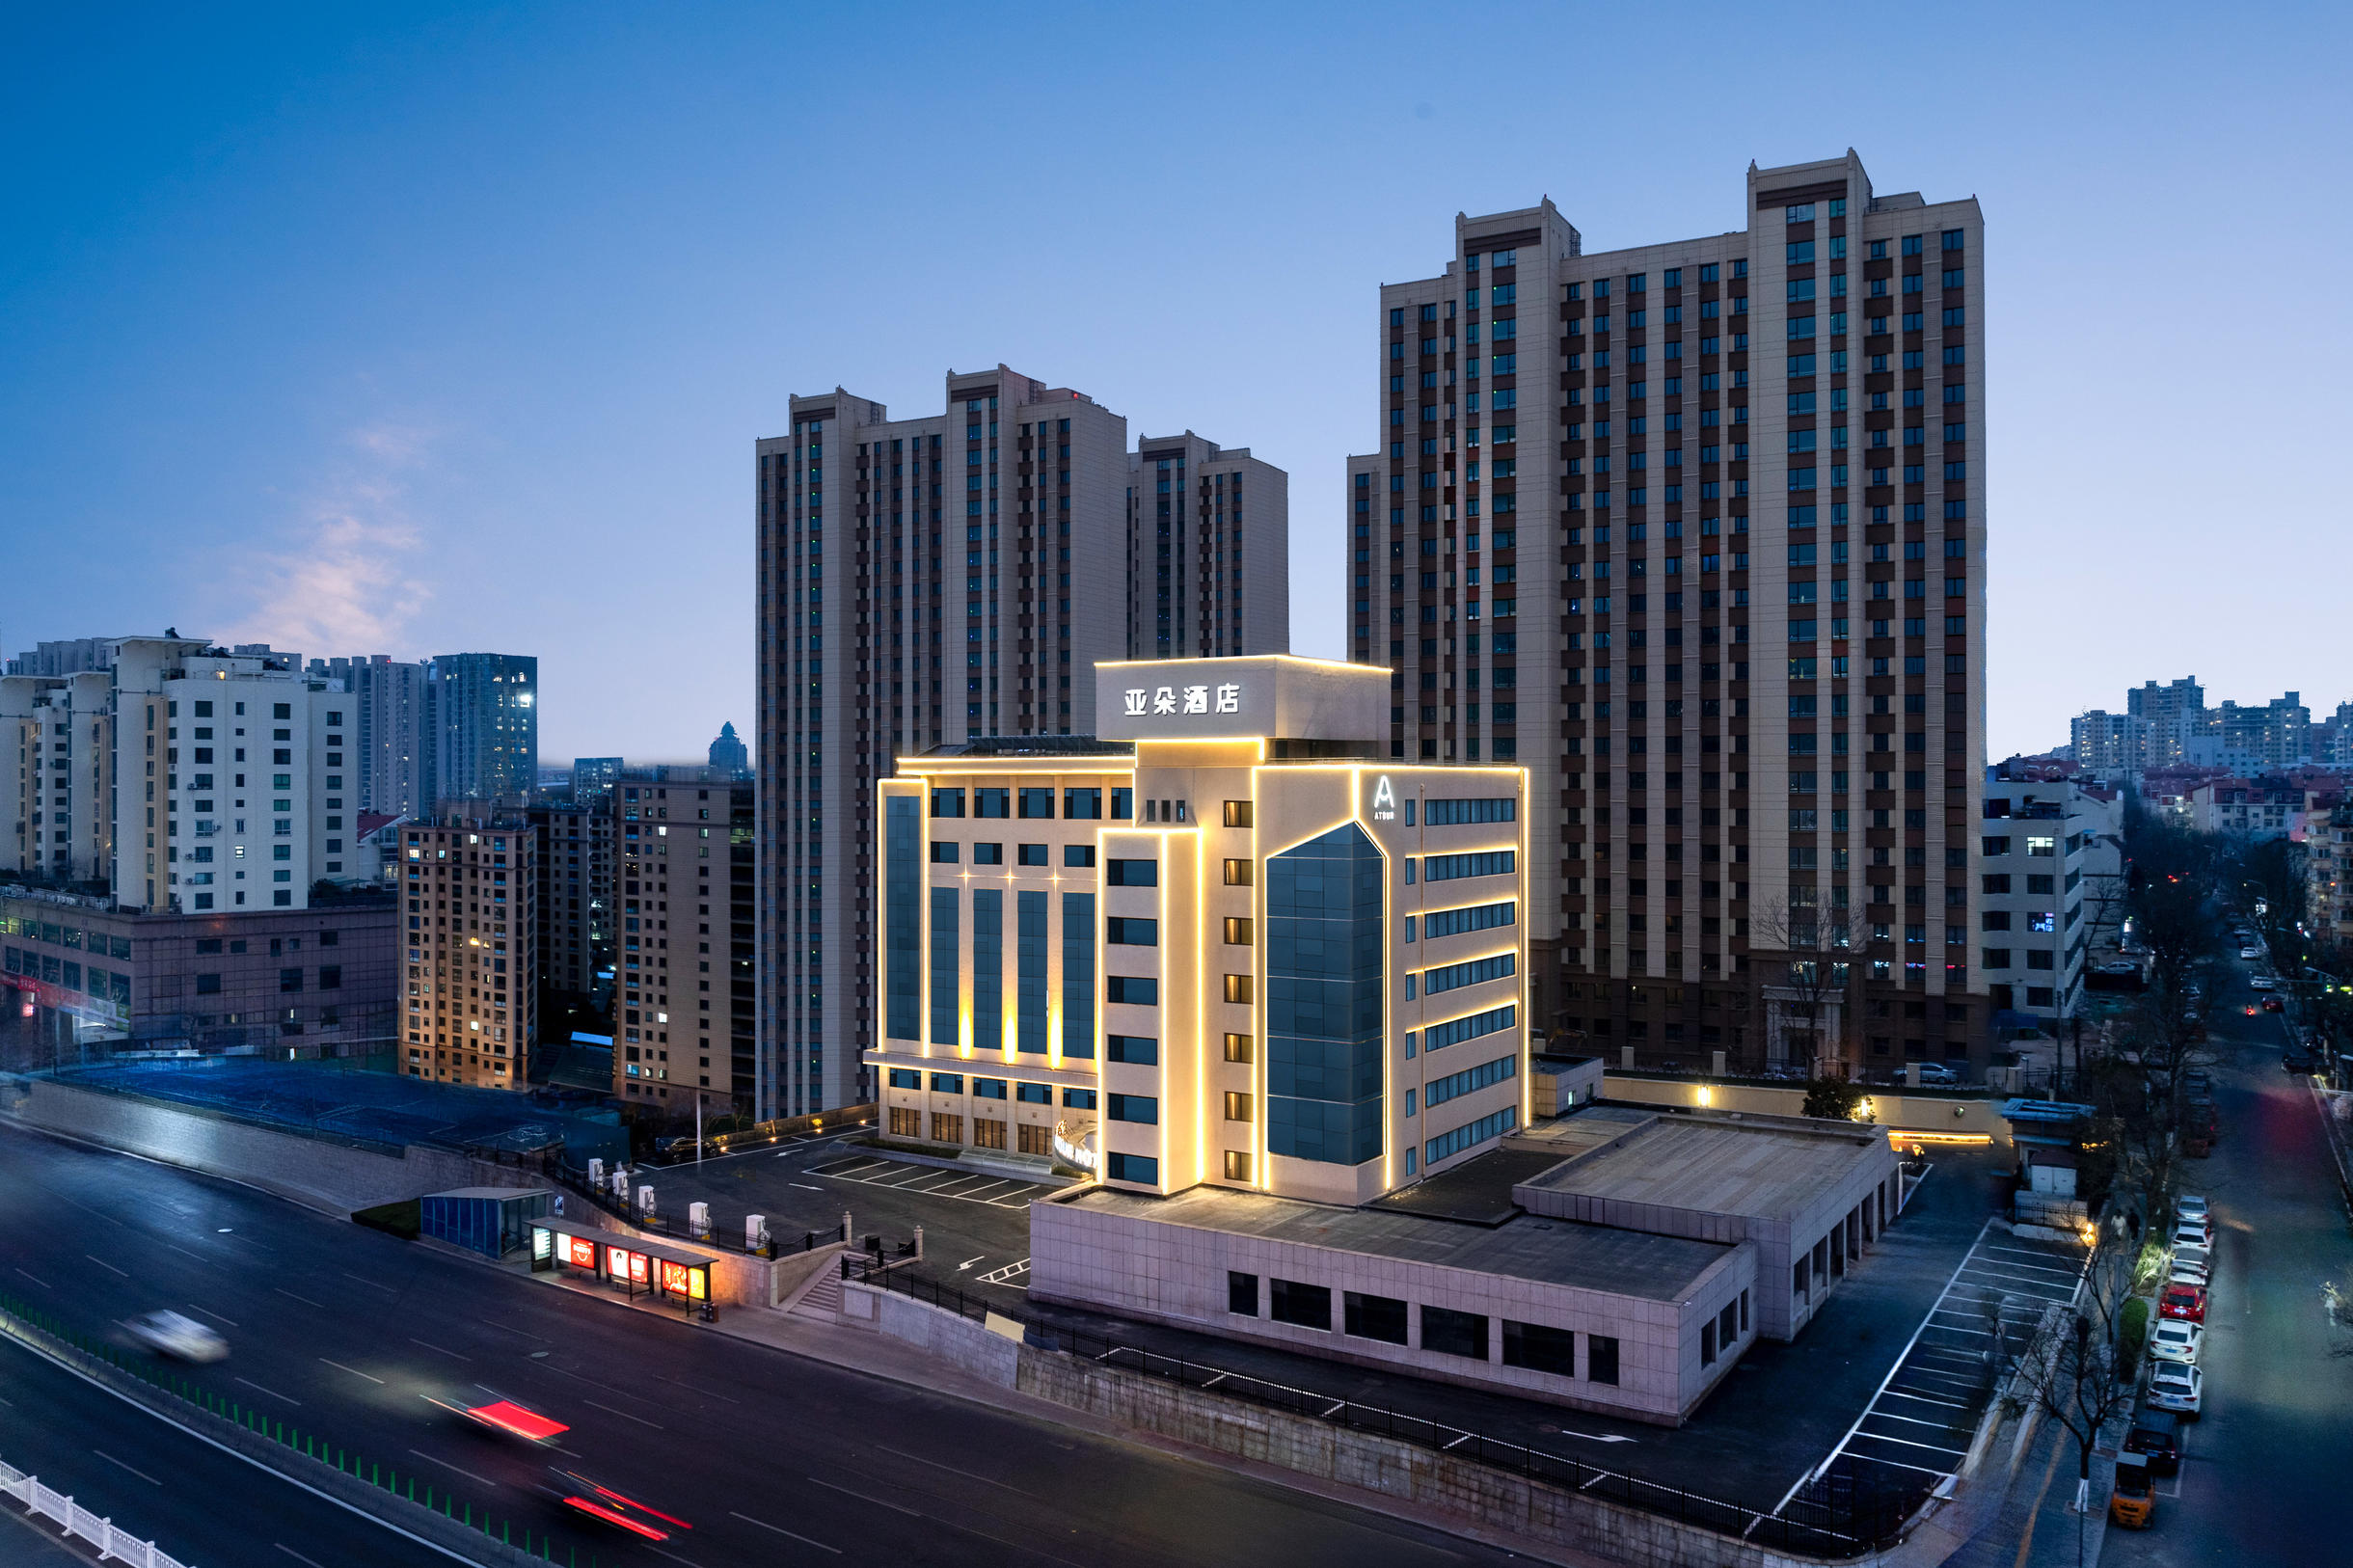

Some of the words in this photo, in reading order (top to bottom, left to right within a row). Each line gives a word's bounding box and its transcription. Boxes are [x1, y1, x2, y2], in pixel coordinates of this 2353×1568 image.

[1124, 683, 1240, 716] 亚朵酒店
[1374, 811, 1394, 821] ATOUR
